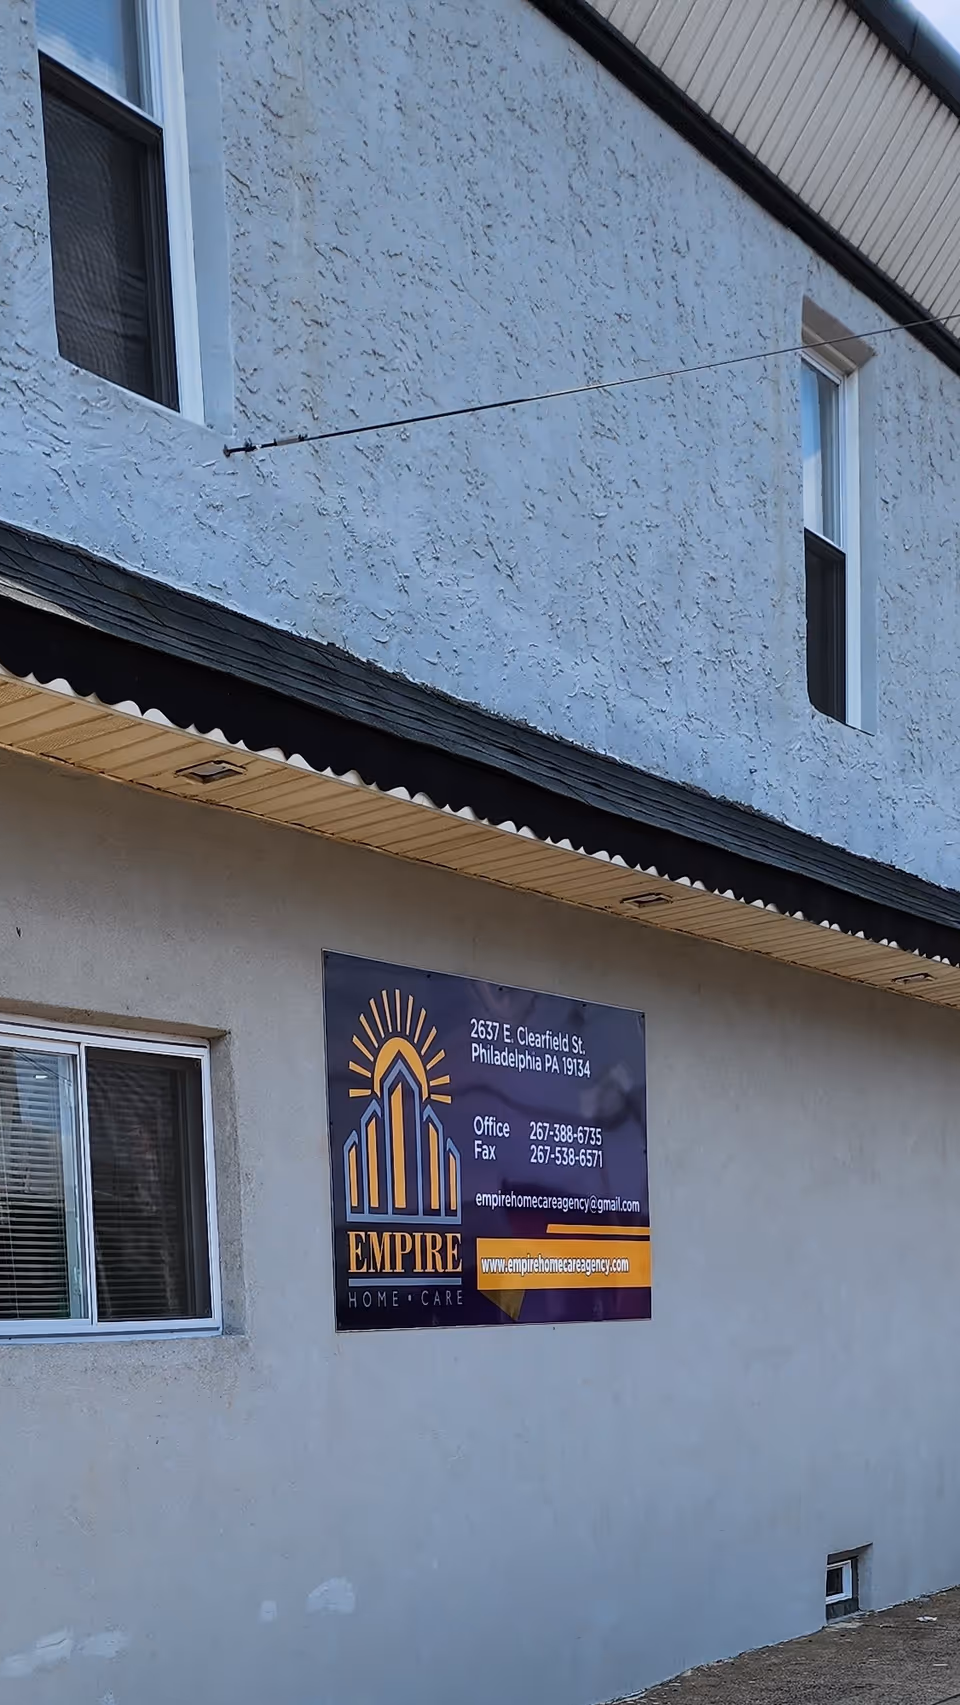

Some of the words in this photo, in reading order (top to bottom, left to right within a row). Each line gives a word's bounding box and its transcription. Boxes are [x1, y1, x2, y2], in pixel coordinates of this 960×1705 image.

[470, 1018, 500, 1041] 2637
[503, 1024, 514, 1044] E.
[517, 1026, 569, 1052] Clearfield
[571, 1035, 586, 1055] St.
[471, 1042, 542, 1072] Philadelphia
[545, 1053, 560, 1074] PA
[562, 1057, 591, 1078] 19134
[473, 1115, 510, 1138] Office
[529, 1121, 602, 1146] 267-388-6735
[474, 1139, 496, 1160] Fax
[530, 1144, 603, 1168] 267-538-6571
[475, 1190, 640, 1213] empirehomecareagency@gmail.com
[347, 1231, 463, 1273] EMPIRE
[481, 1253, 630, 1277] www.empirehomecareagency.com
[348, 1291, 399, 1308] HOME
[421, 1290, 464, 1306] CARE
